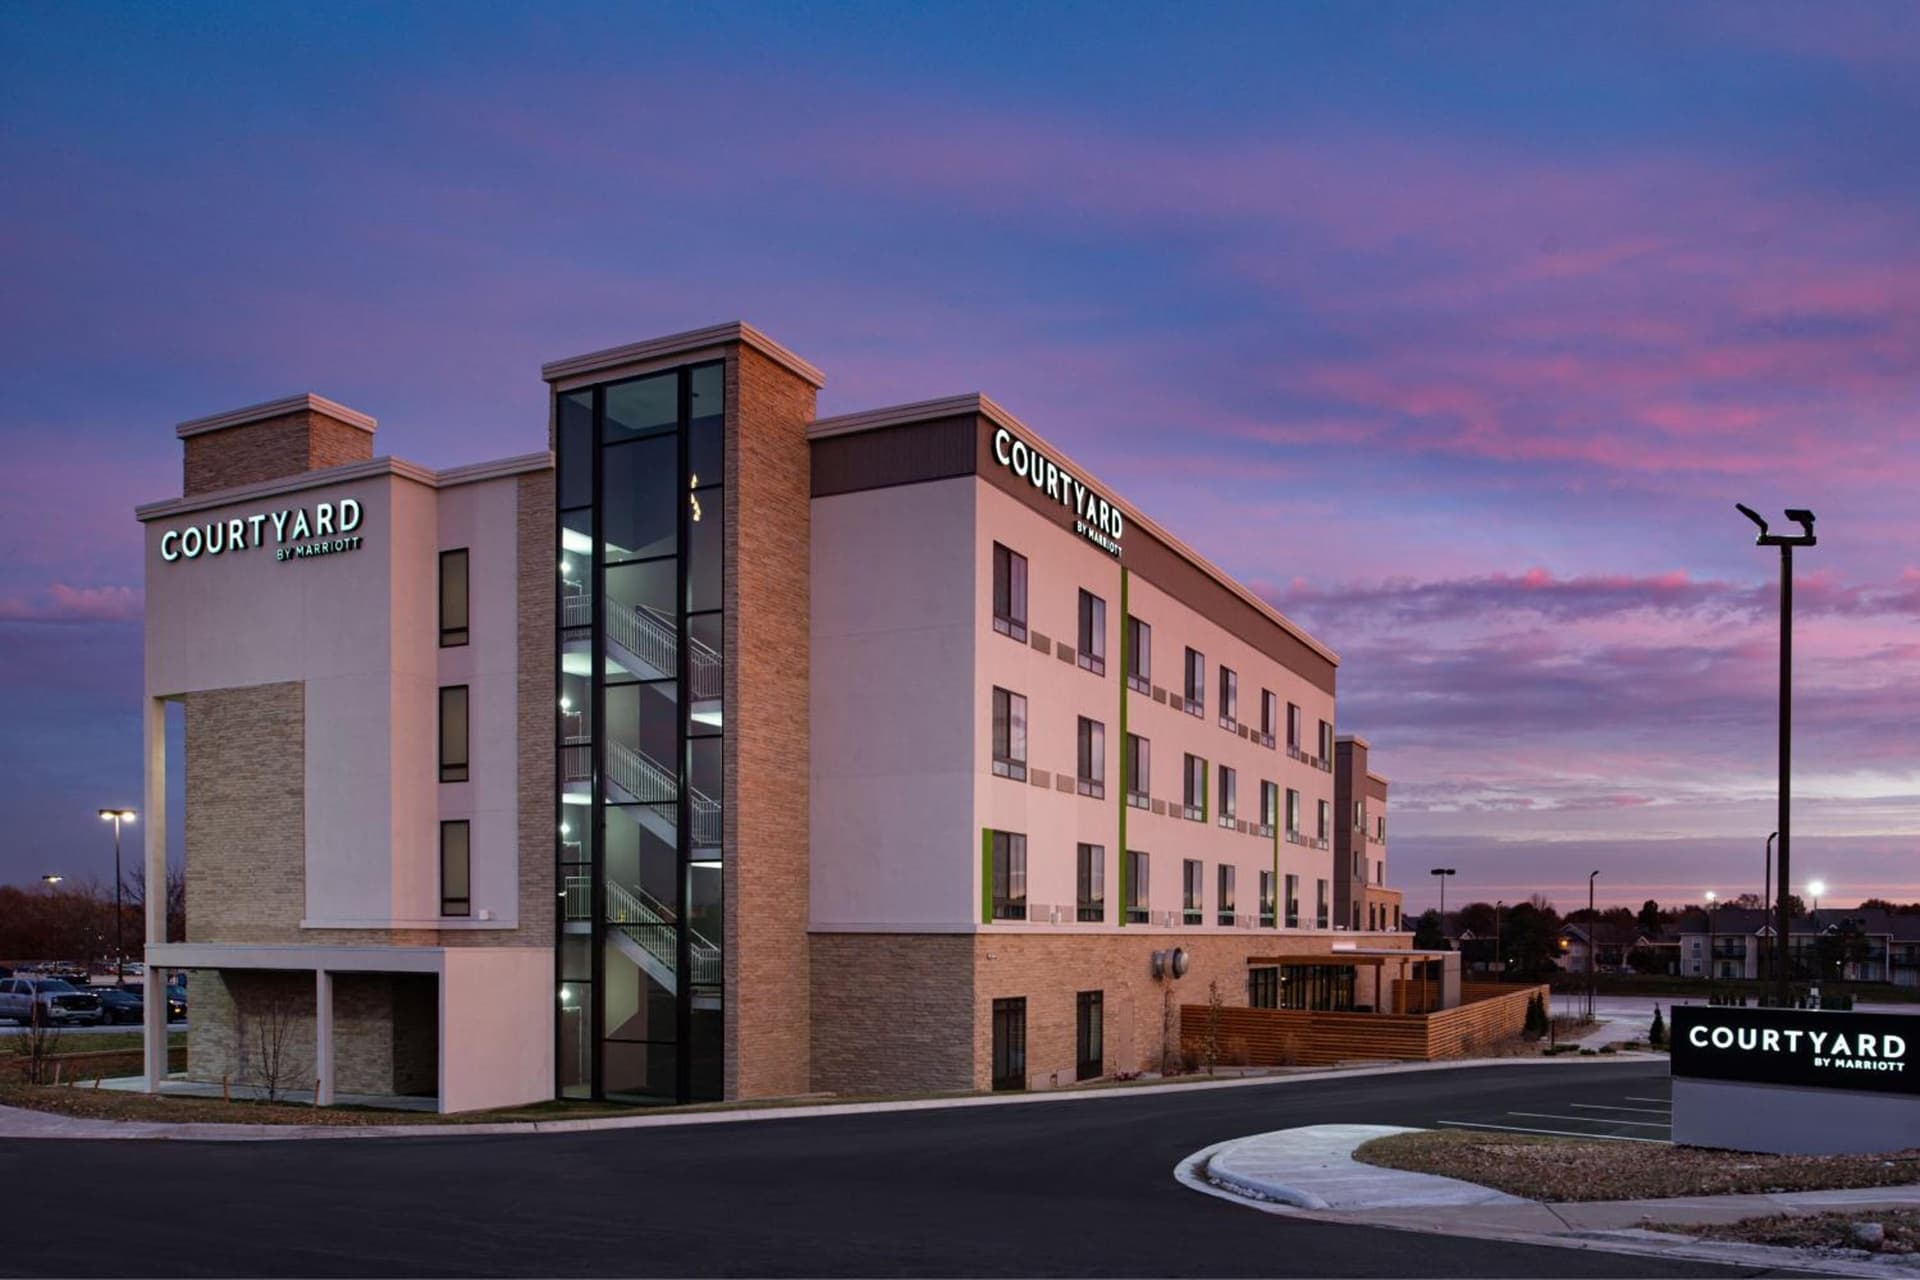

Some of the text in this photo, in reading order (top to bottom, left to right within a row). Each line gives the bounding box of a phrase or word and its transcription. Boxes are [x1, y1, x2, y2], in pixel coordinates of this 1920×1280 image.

[995, 428, 1123, 539] COURTYARD
[161, 498, 361, 562] COURTYARD
[1077, 520, 1123, 557] BY MARRIOTT
[276, 536, 361, 561] BY MARRIOTT
[1688, 1025, 1906, 1059] COURTYARD
[1814, 1057, 1905, 1072] BY MARRIOTT
